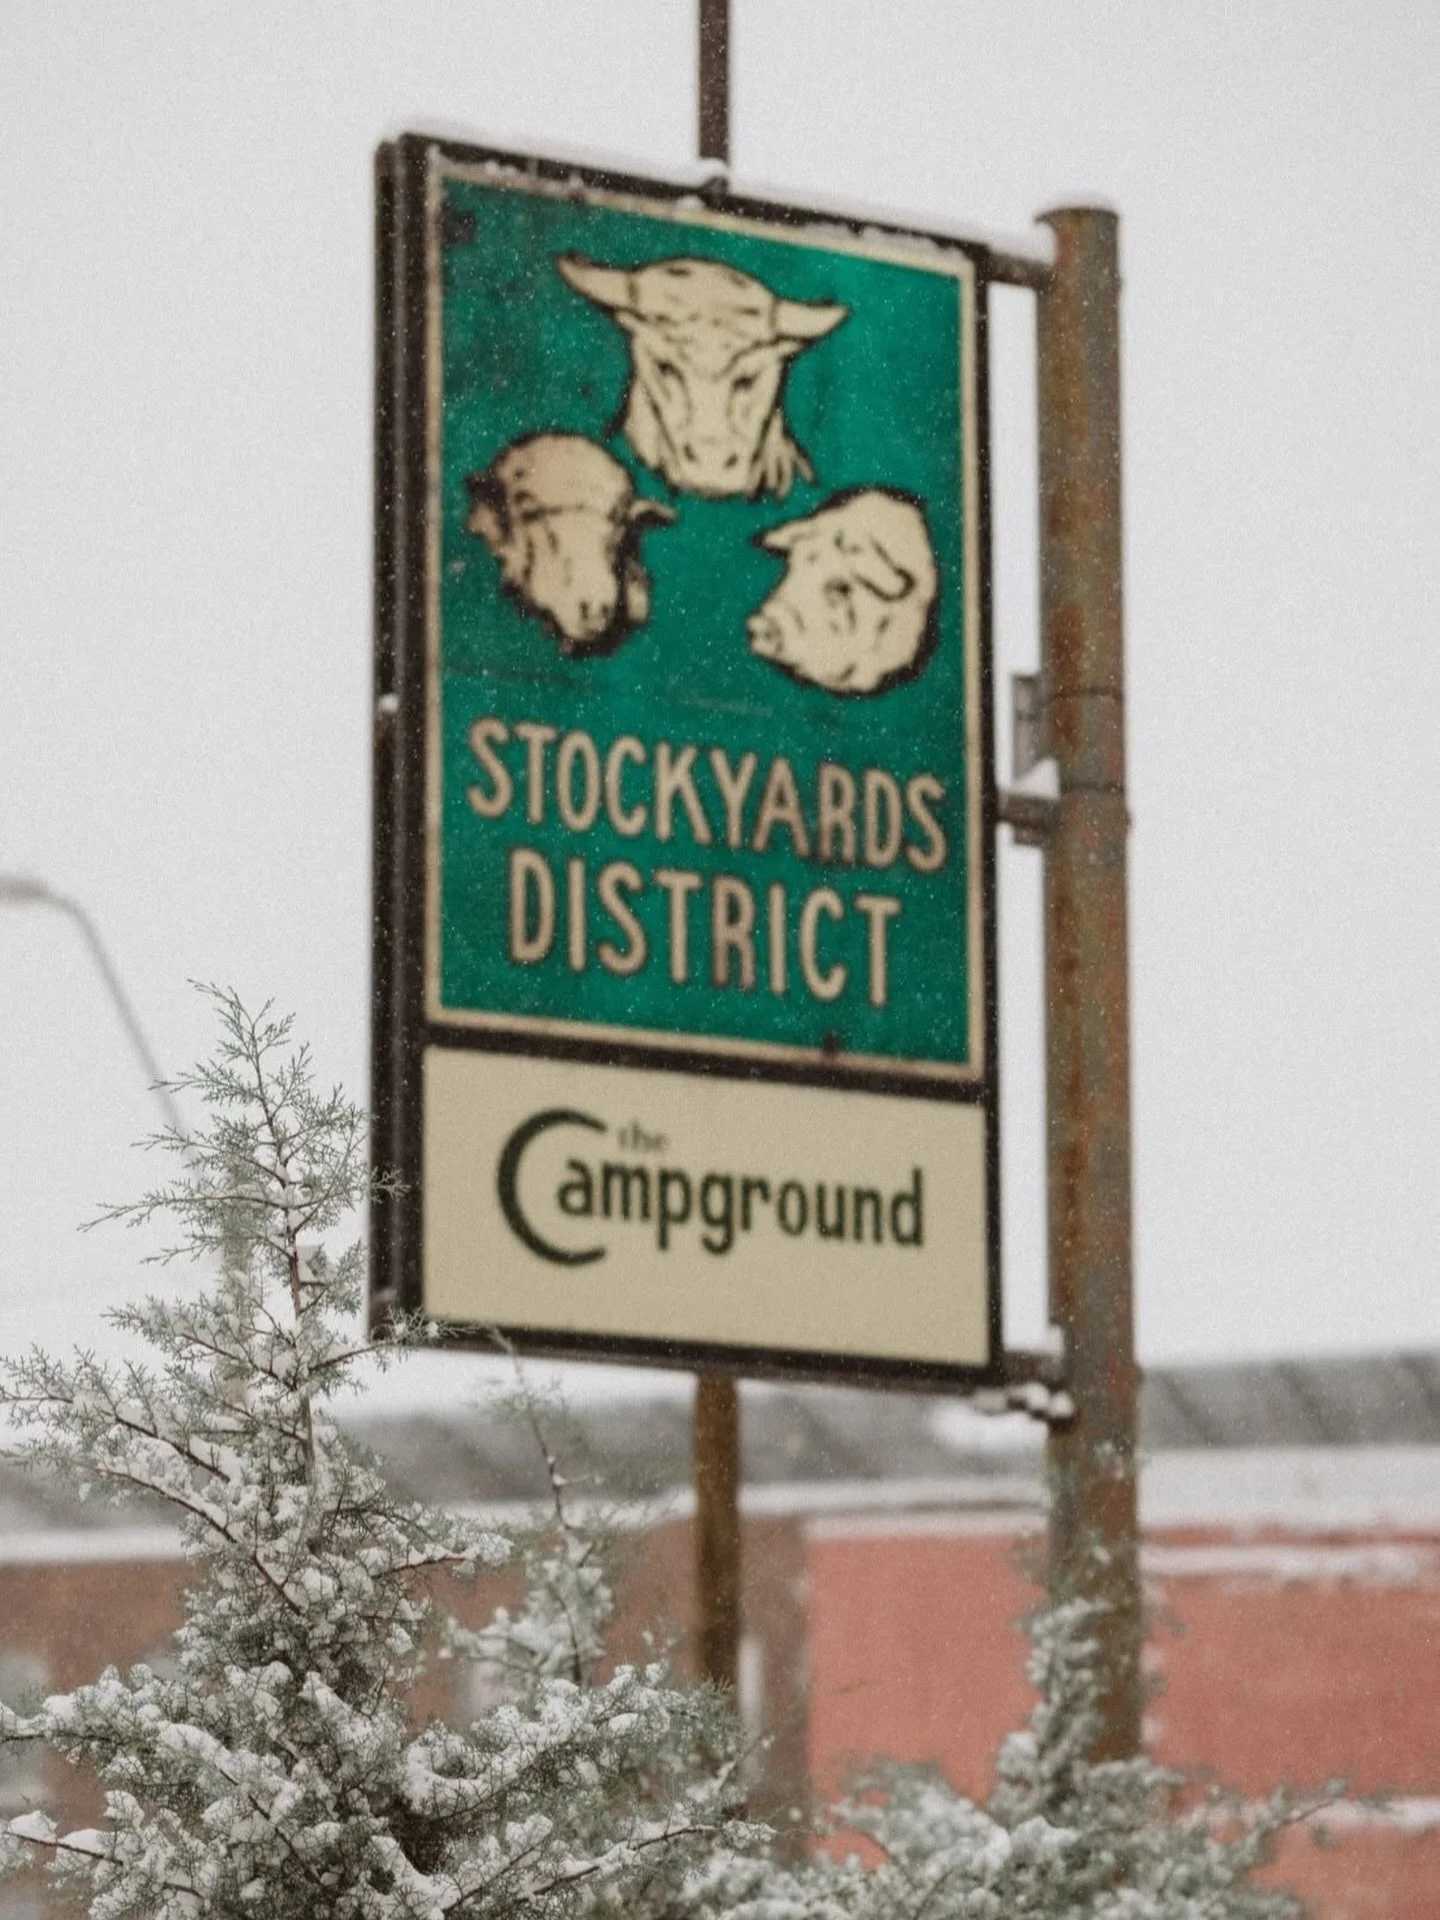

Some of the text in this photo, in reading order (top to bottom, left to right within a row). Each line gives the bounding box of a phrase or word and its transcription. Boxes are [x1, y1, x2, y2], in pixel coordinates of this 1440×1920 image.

[467, 715, 948, 873] STOCKYARDS
[508, 846, 902, 1007] DISTRICT
[497, 1107, 925, 1267] Campground
[617, 1119, 669, 1154] the
